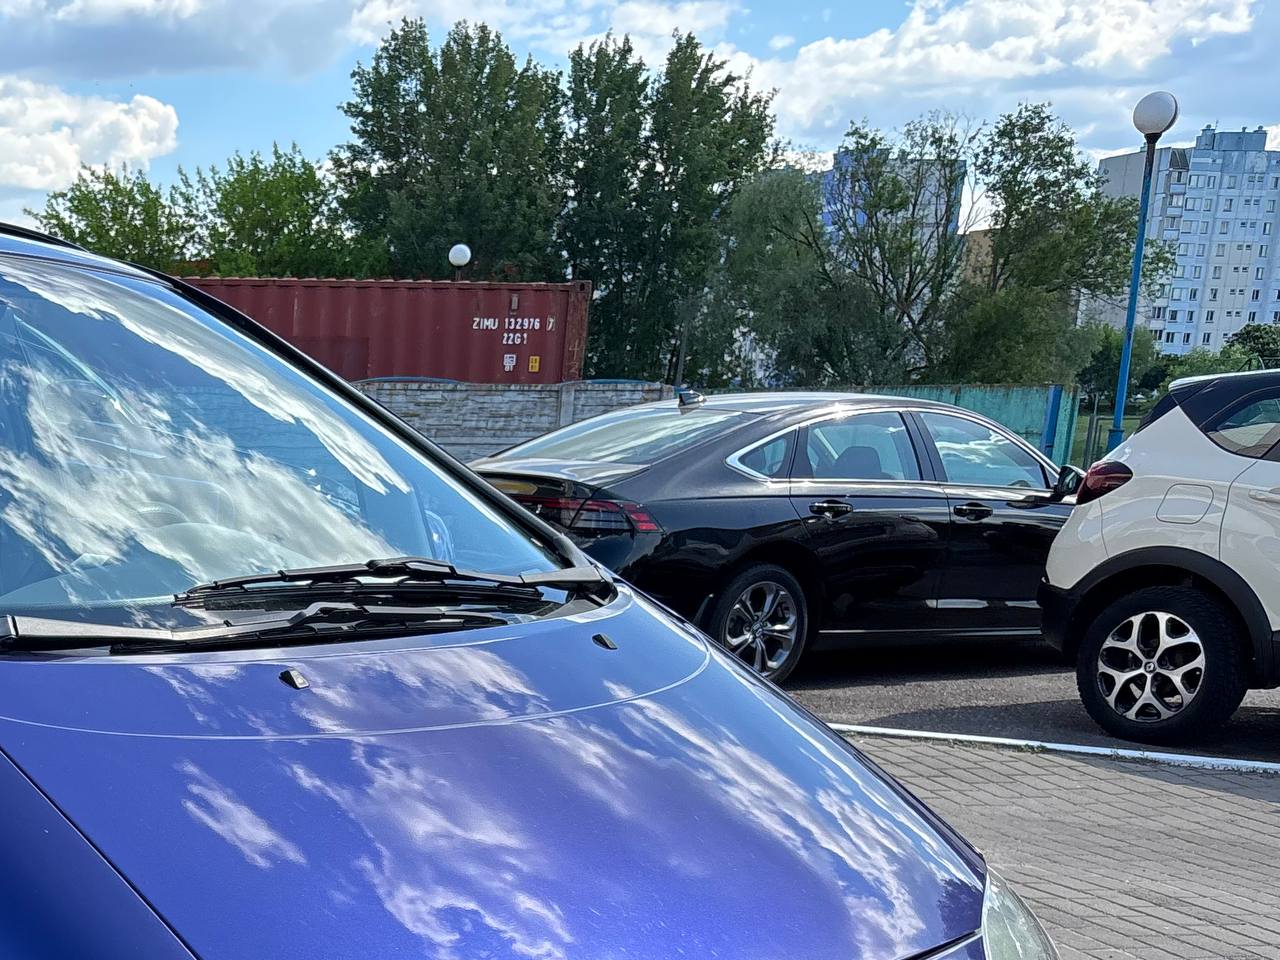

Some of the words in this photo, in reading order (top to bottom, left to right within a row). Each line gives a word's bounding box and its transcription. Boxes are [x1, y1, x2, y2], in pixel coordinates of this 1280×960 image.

[472, 317, 498, 330] ZIMU
[504, 317, 540, 330] 132976
[502, 332, 528, 345] 22G1
